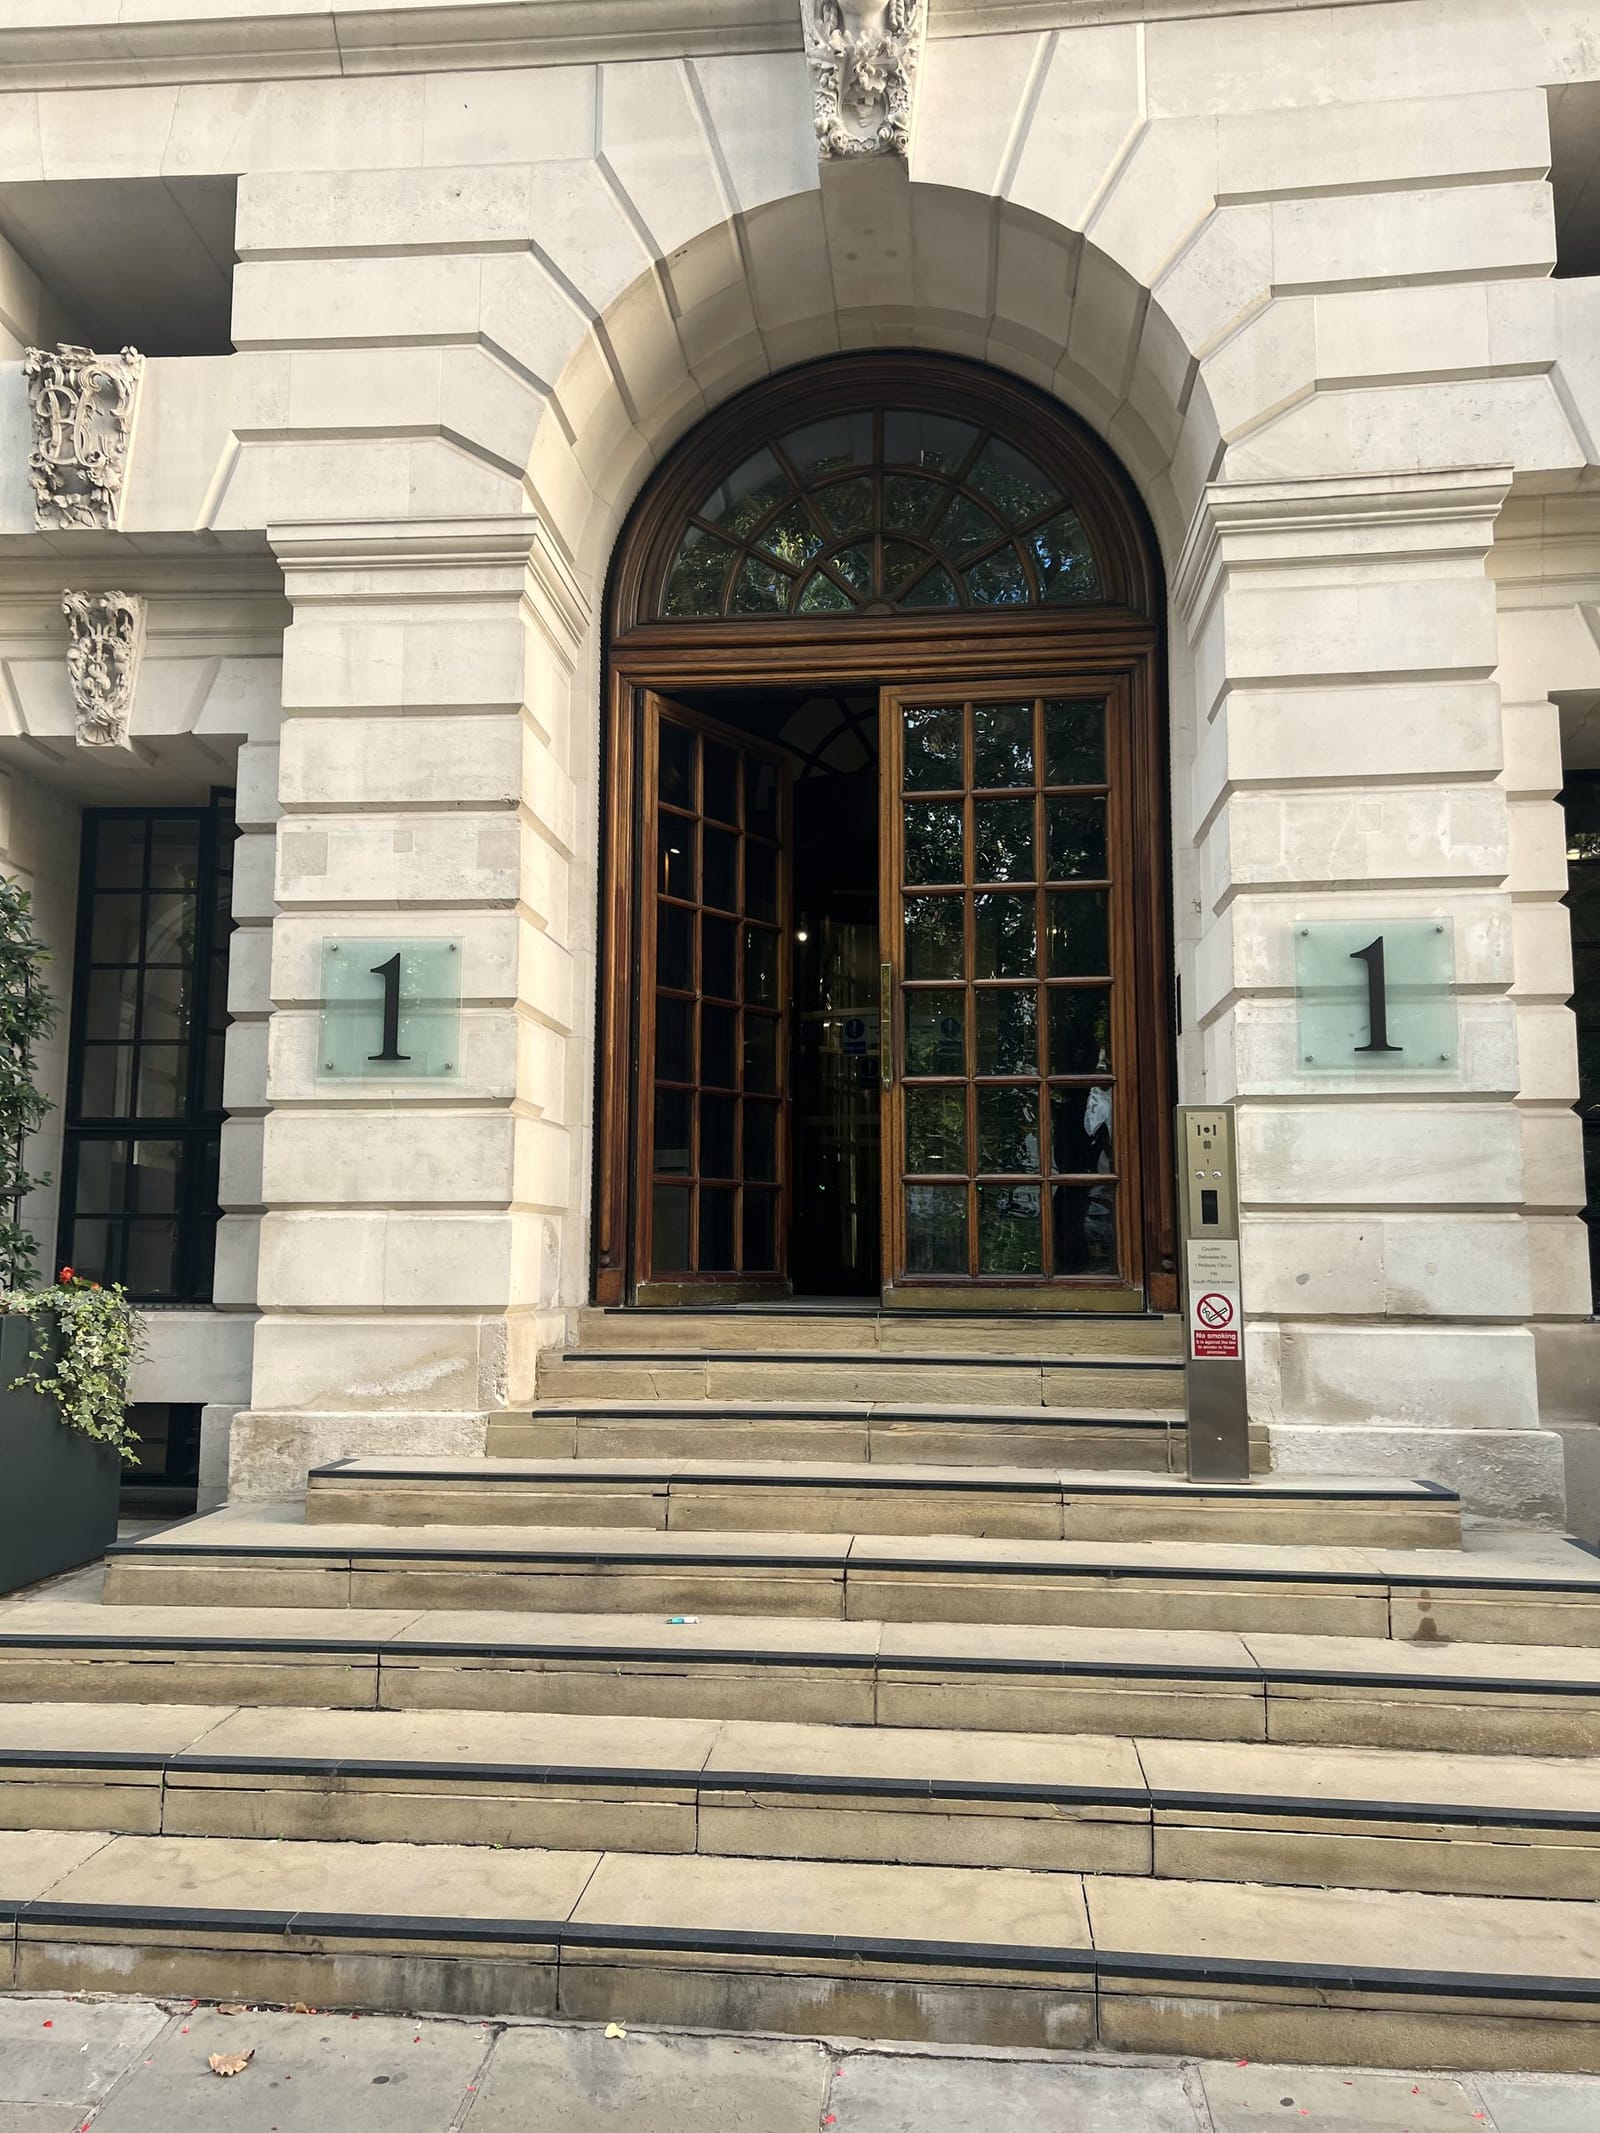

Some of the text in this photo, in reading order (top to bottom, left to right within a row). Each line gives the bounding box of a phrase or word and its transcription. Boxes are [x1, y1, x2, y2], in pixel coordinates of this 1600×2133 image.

[368, 953, 411, 1060] 1
[1350, 936, 1403, 1051] 1
[1207, 1332, 1236, 1341] smoking
